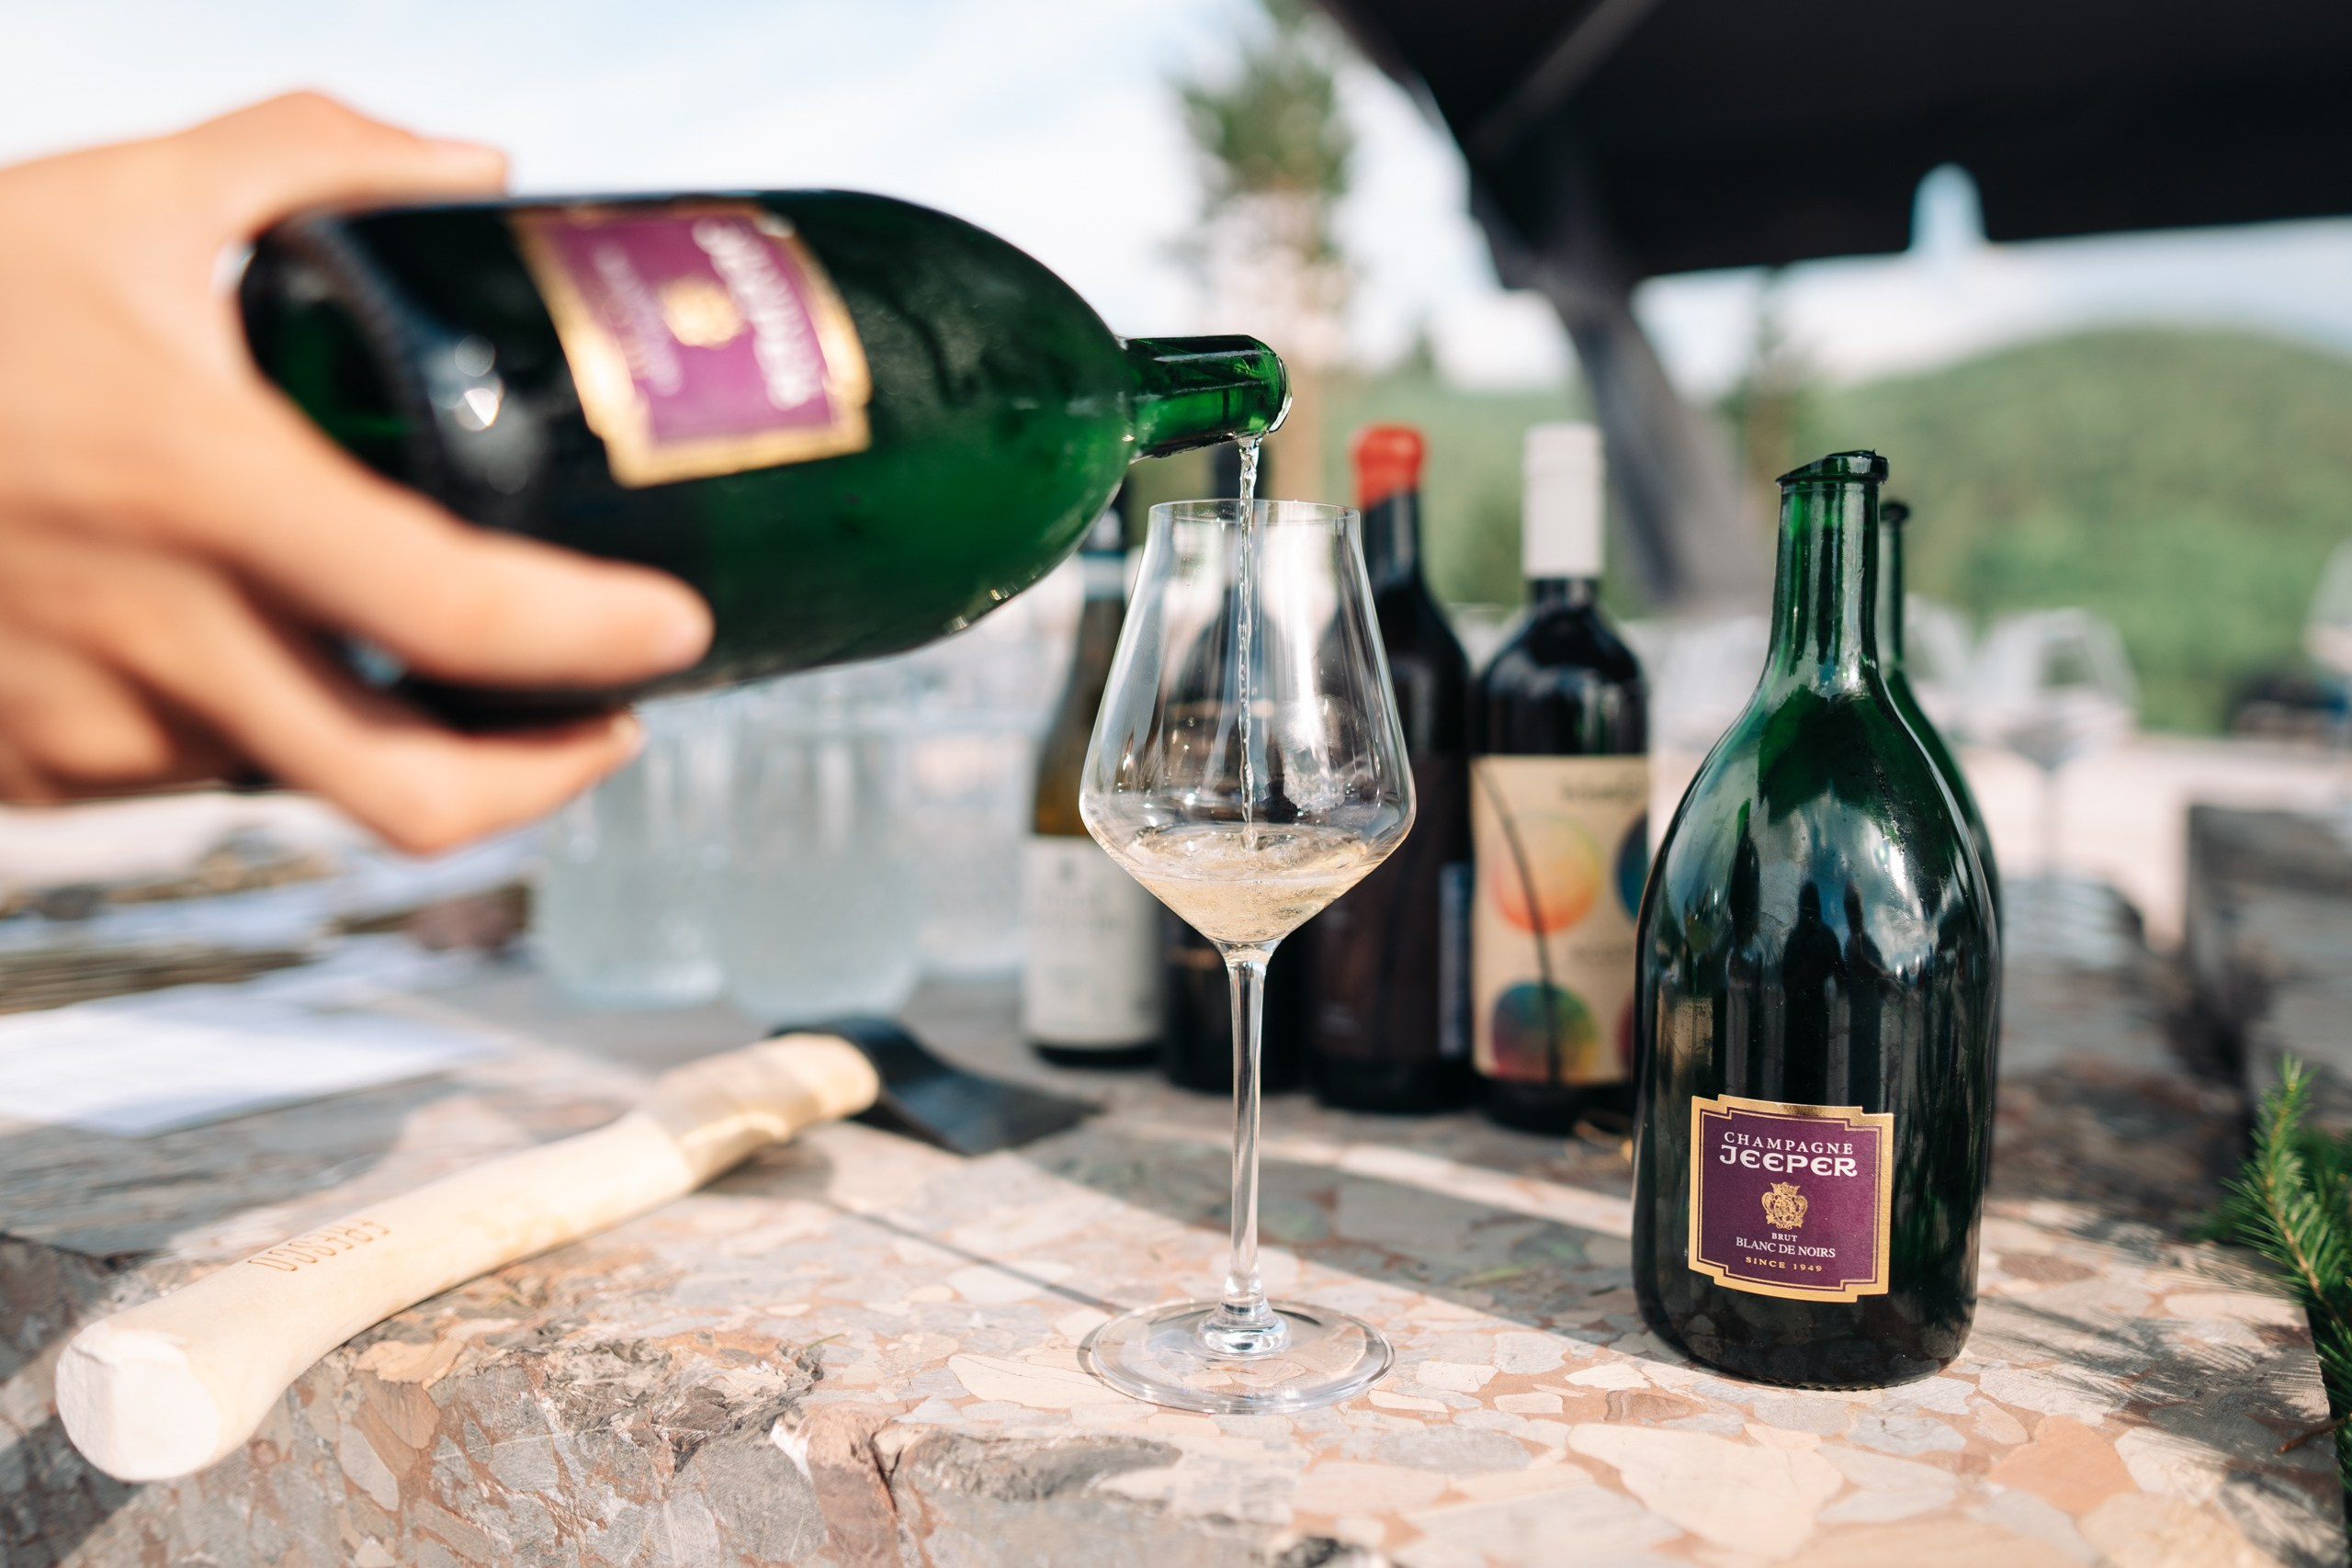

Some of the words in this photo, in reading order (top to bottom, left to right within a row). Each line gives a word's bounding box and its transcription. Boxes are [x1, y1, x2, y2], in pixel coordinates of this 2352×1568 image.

[1724, 1132, 1852, 1155] CHAMPAGNE
[1719, 1145, 1858, 1177] JEEPER
[1736, 1236, 1776, 1253] BLANC
[1779, 1244, 1796, 1256] DE
[1797, 1246, 1836, 1258] NOIRS
[1771, 1232, 1798, 1243] BRUT
[1745, 1256, 1786, 1269] SINCE
[1792, 1263, 1823, 1273] 1949
